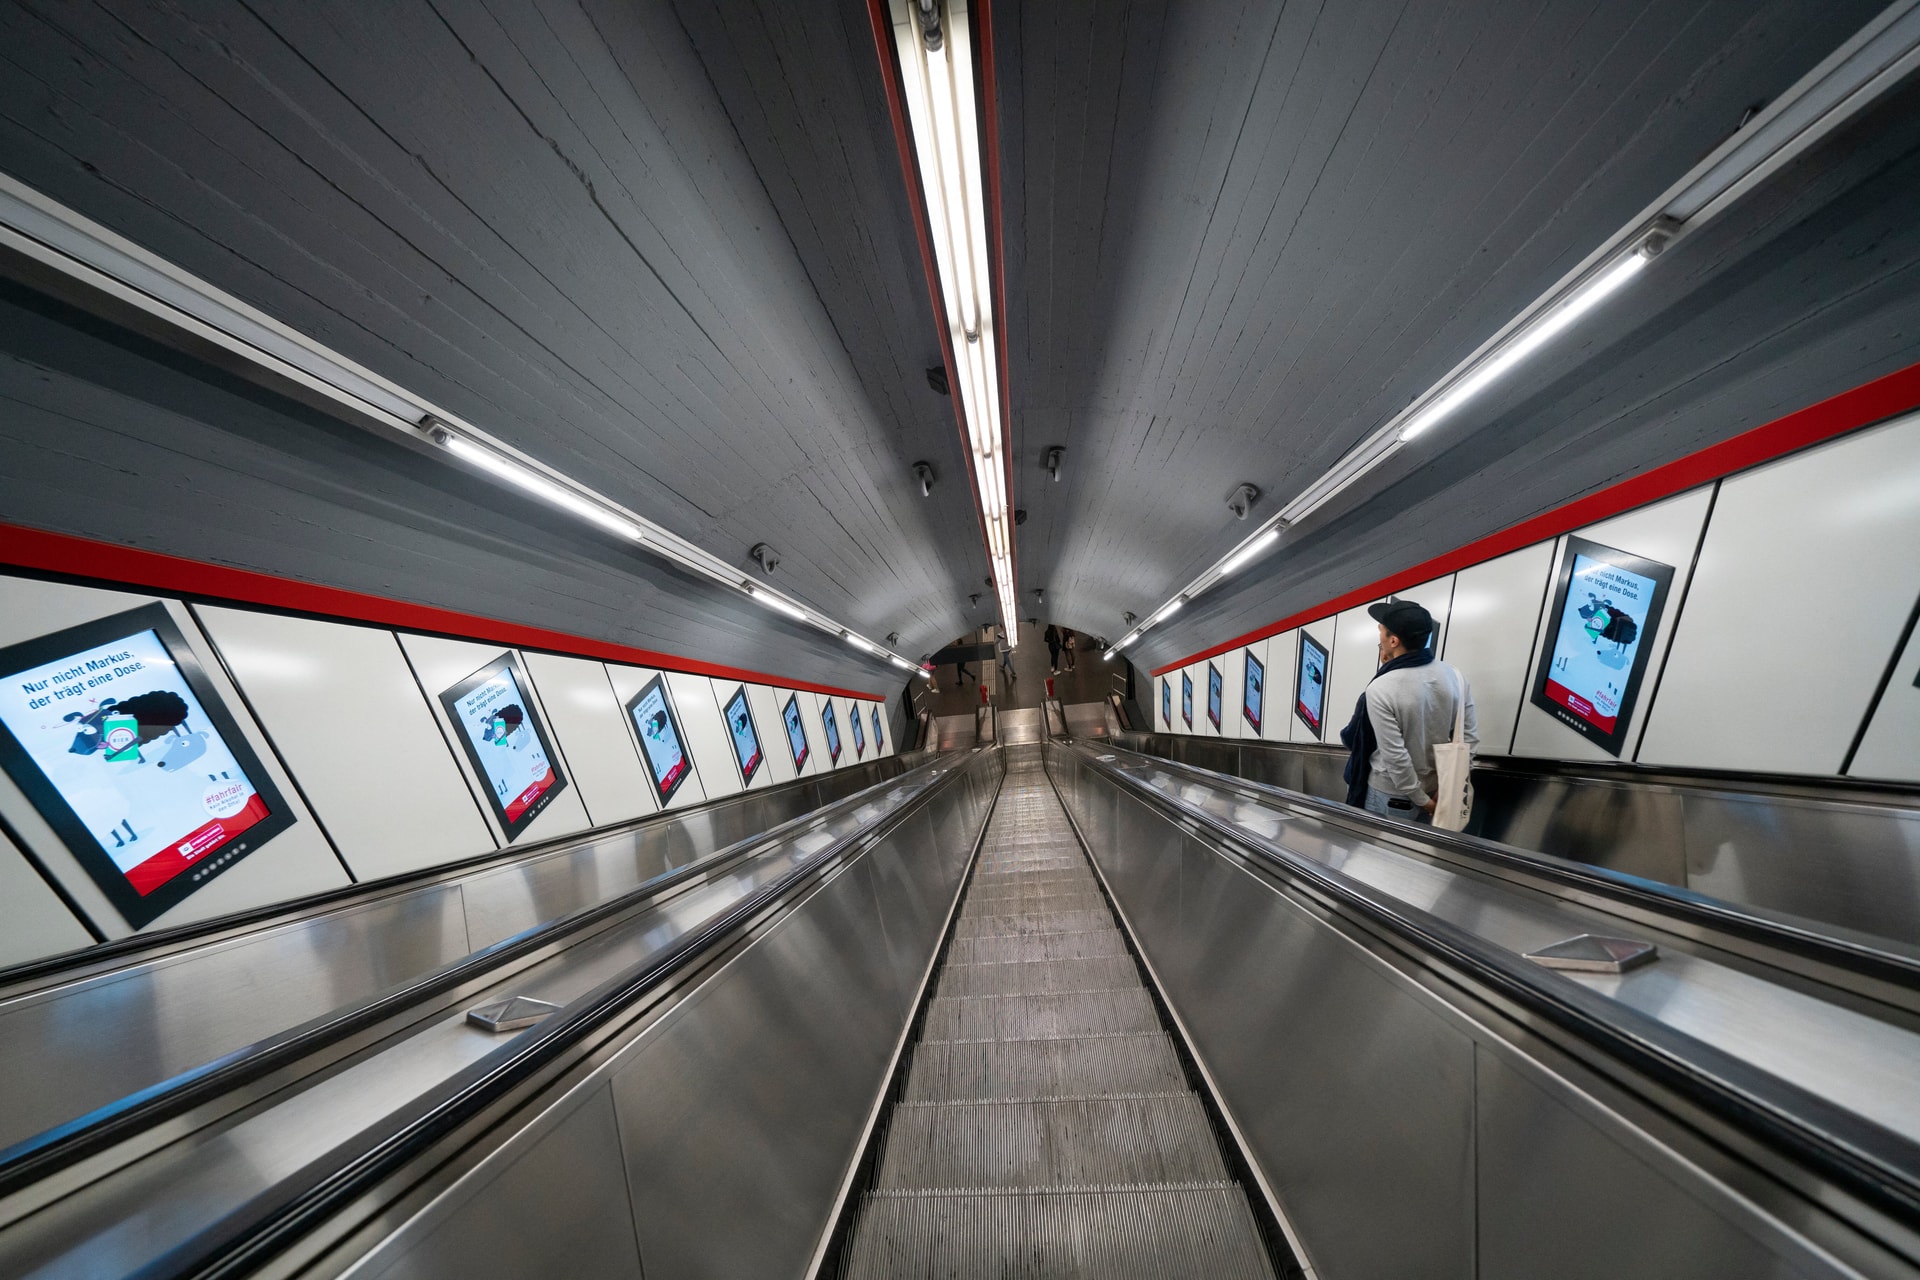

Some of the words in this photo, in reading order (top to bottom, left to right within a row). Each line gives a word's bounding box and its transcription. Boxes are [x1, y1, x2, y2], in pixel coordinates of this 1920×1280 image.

[1594, 578, 1609, 590] trägt
[1608, 584, 1622, 594] eine
[1622, 588, 1639, 601] Dose.
[1615, 575, 1639, 591] Markus,
[21, 679, 49, 695] Nur
[51, 665, 86, 685] nicht
[85, 650, 135, 672] Markus,
[28, 695, 52, 710] der
[53, 681, 87, 701] trägt
[87, 672, 114, 688] eine
[113, 661, 147, 678] Dose.
[206, 784, 242, 803] #fahrfair
